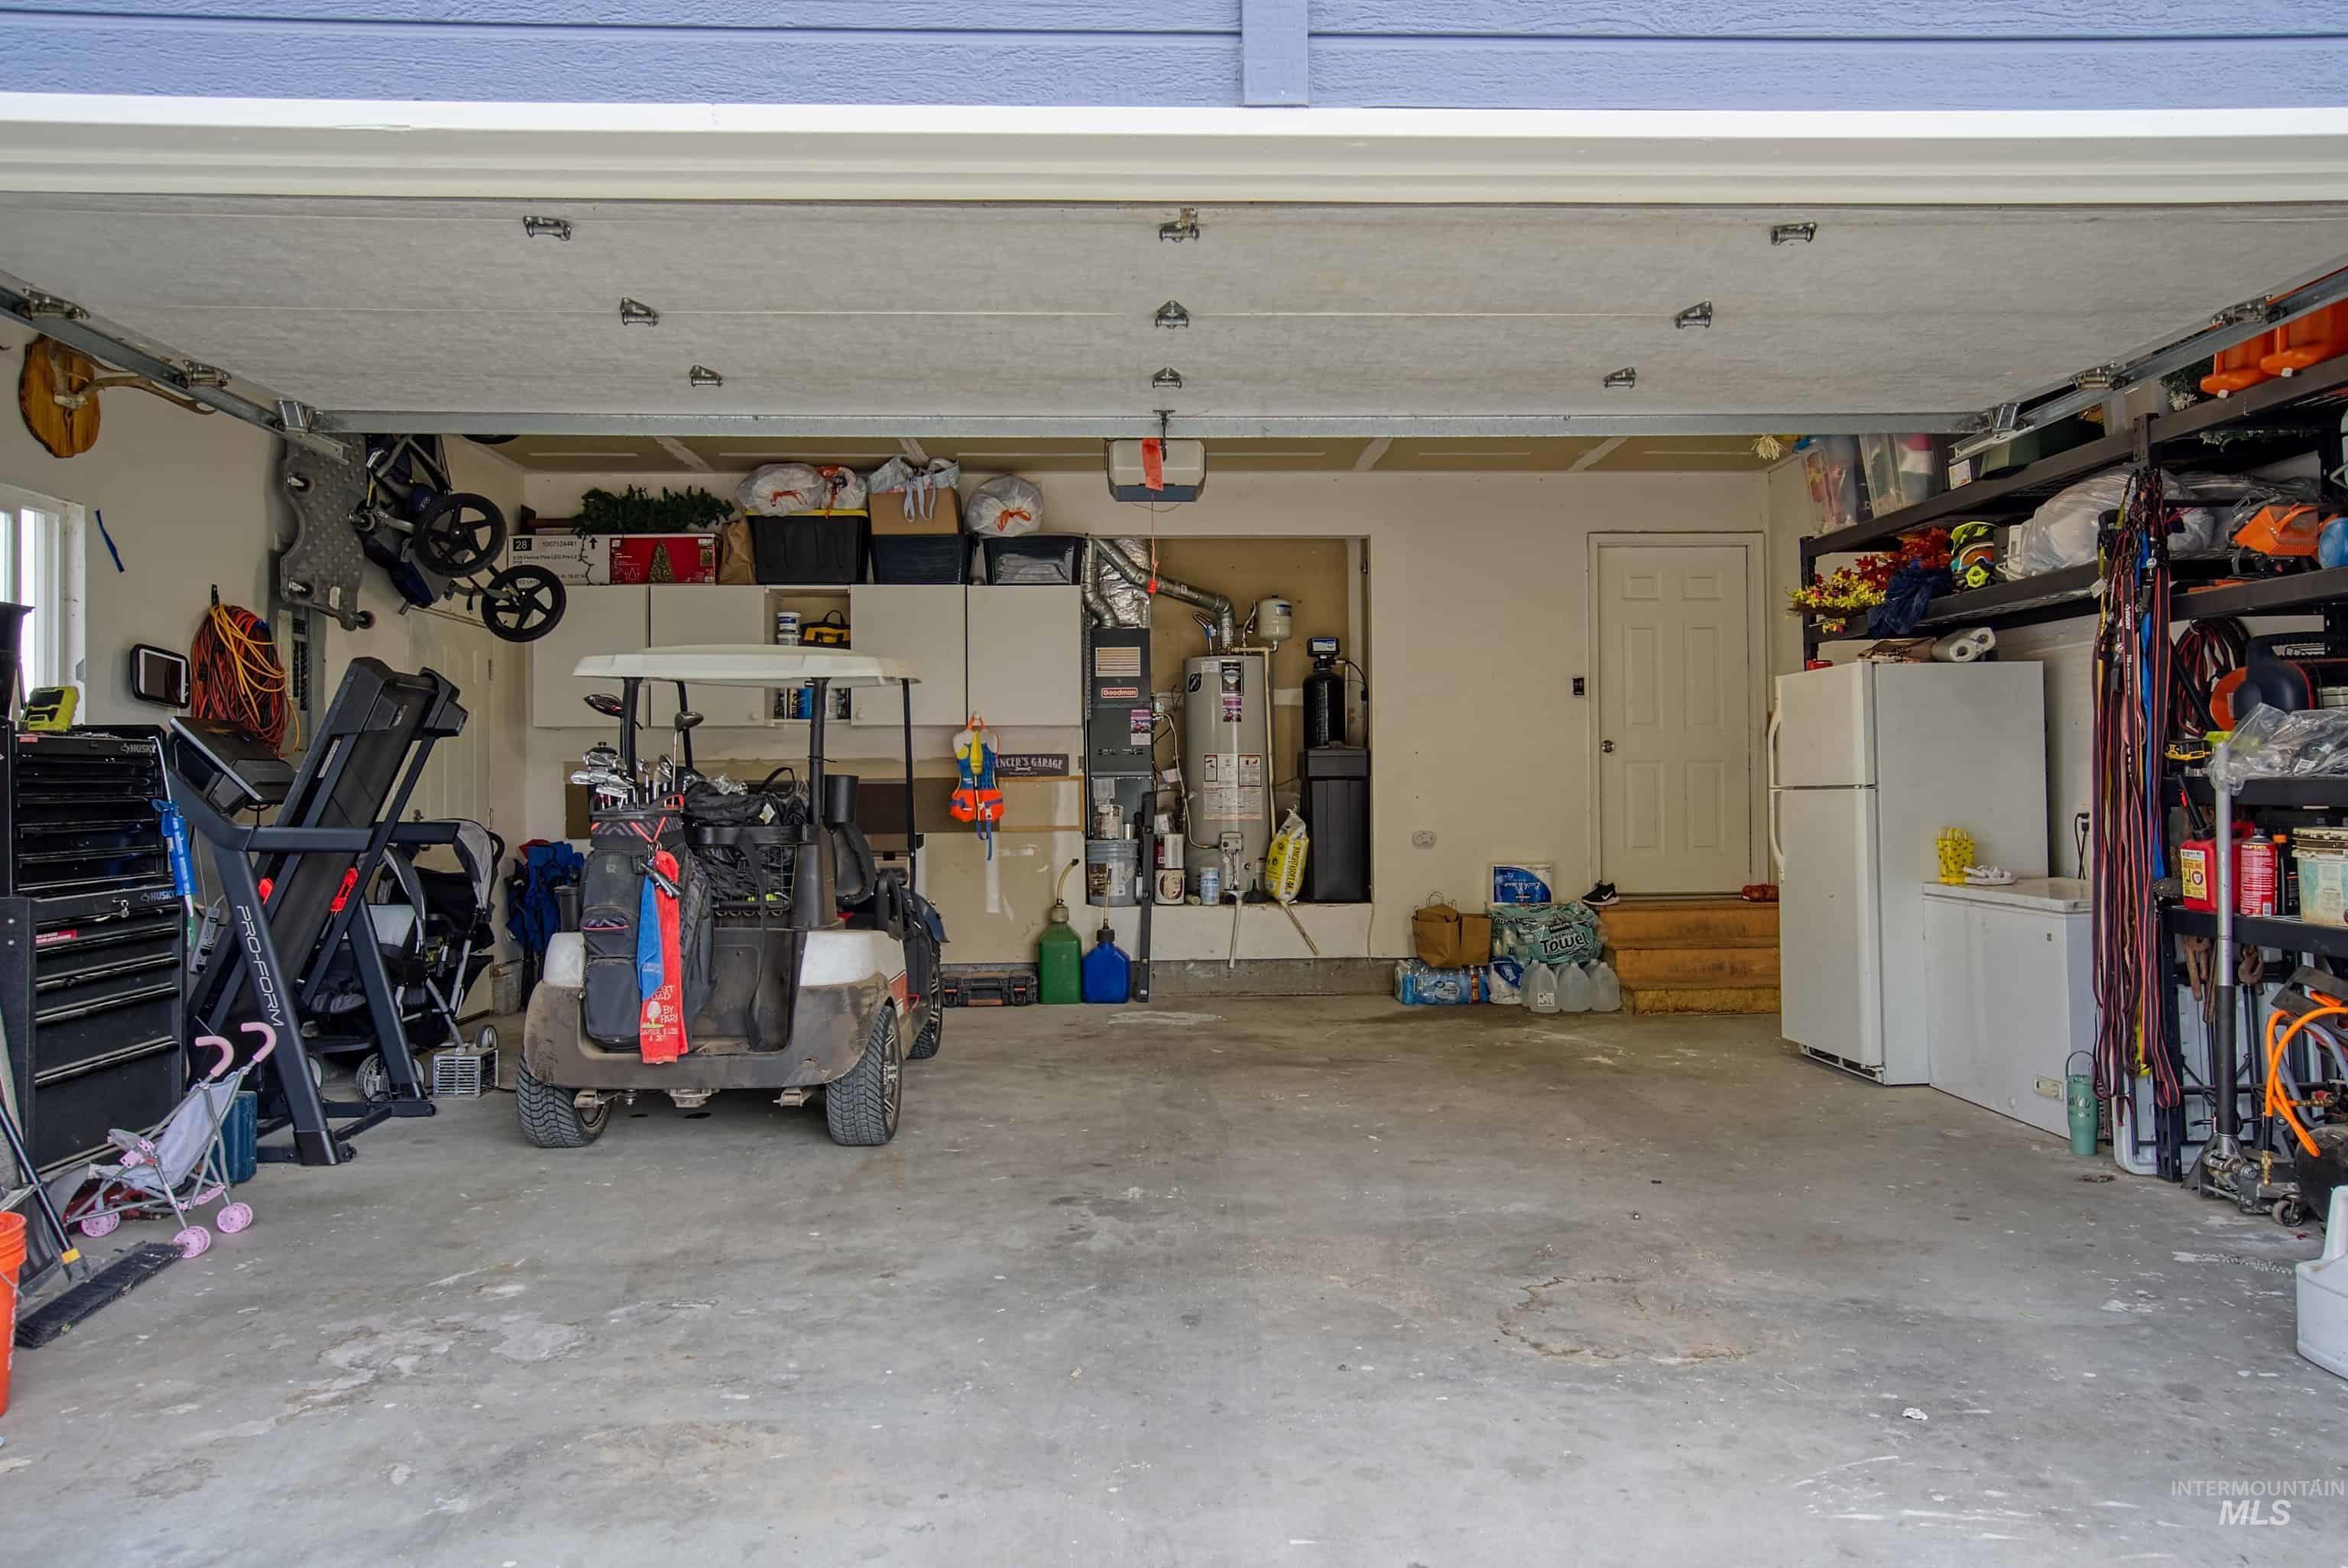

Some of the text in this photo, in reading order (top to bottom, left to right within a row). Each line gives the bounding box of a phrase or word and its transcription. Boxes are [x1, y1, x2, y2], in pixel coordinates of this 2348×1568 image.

[515, 540, 527, 549] 28
[130, 744, 157, 754] HUSKY
[996, 756, 1063, 769] ENCER'S GARAGE
[1539, 931, 1590, 955] Towel
[236, 905, 284, 1026] PRO-FORM
[662, 1005, 673, 1015] BY
